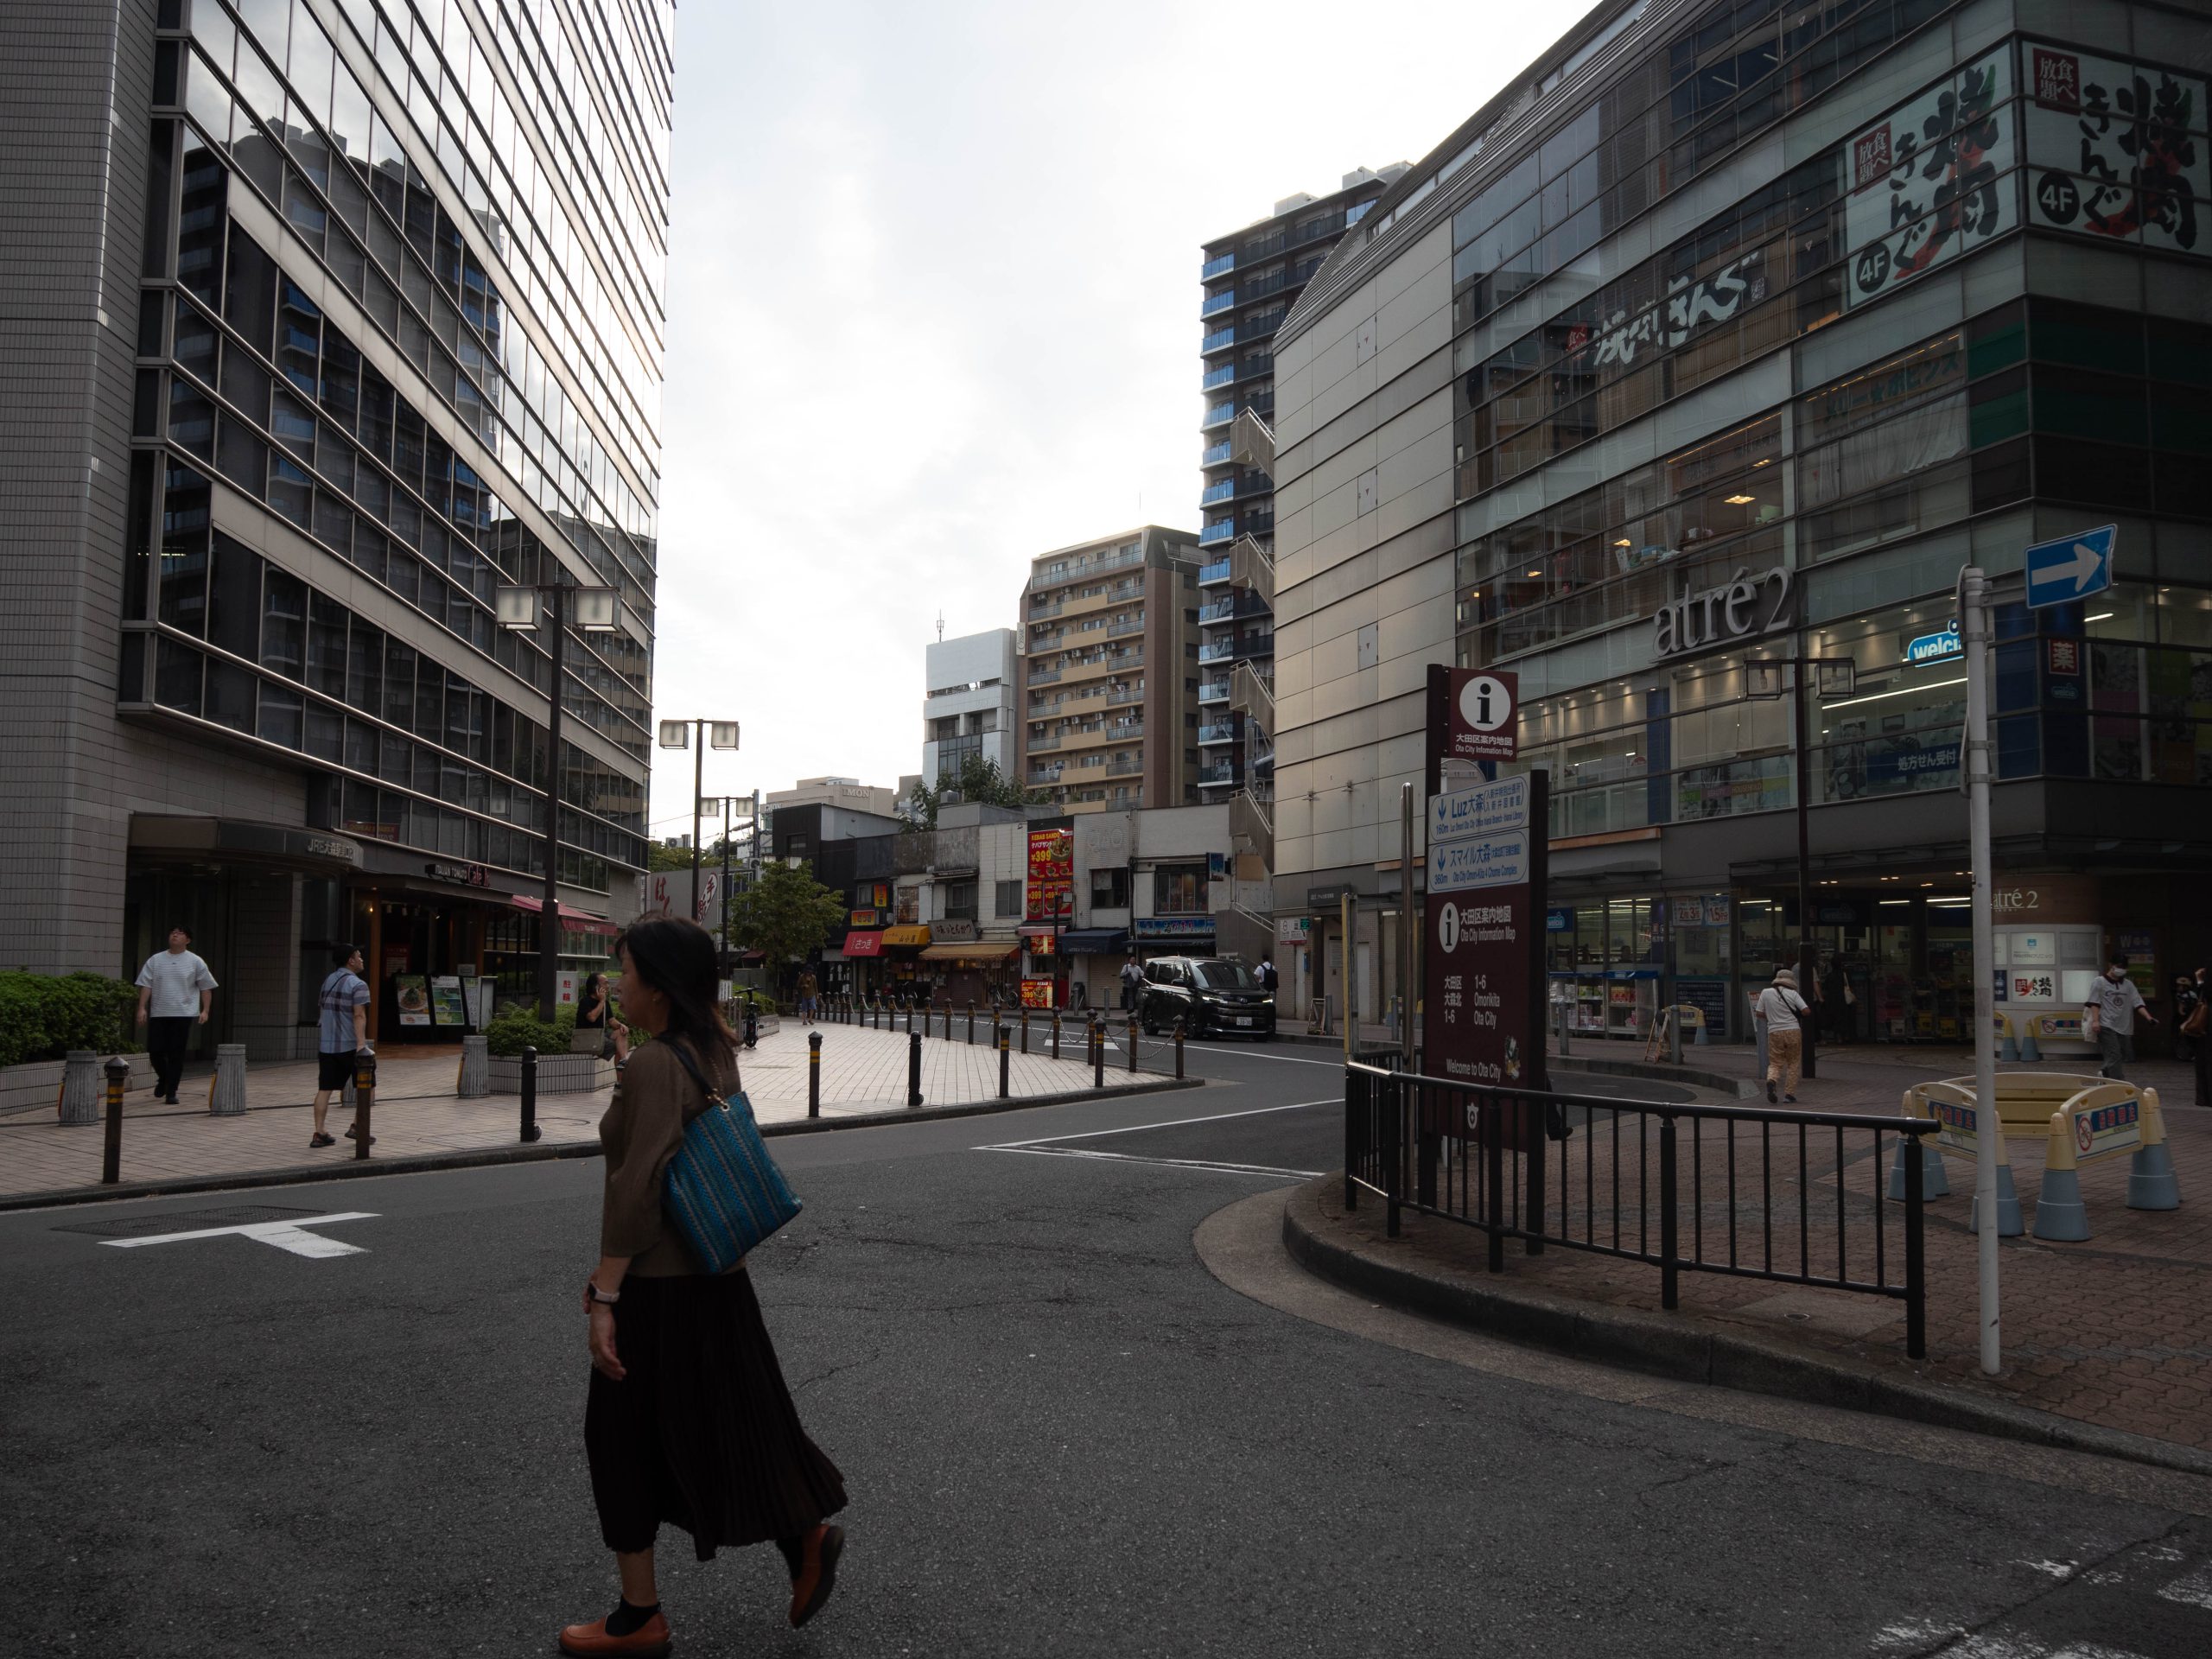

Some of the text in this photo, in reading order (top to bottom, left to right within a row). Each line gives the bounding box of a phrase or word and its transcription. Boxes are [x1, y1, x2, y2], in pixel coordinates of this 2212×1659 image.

[2078, 82, 2122, 232] きんぐ
[1890, 131, 1928, 270] きんぐ
[2042, 183, 2074, 212] 4F
[1859, 251, 1886, 284] 4F
[1653, 566, 1792, 657] atré 2
[2052, 642, 2075, 670] 薬
[1455, 733, 1514, 747] 大田区案内地図
[1455, 744, 1465, 753] Ota
[1465, 745, 1476, 755] City
[1503, 747, 1514, 757] Map
[1897, 748, 1957, 772] 処方せん受付
[842, 787, 871, 798] IMON
[1031, 849, 1052, 862] ¥399
[1450, 843, 1491, 868] スマイル大森
[1993, 888, 2039, 909] atré 2
[1460, 906, 1512, 925] 大田区案内地図
[855, 938, 873, 950] さつき
[1460, 925, 1516, 944] Ota City Information Map
[1444, 976, 1463, 990] 大田区
[1474, 975, 1487, 989] 1-6
[1445, 1008, 1456, 1023] 1-6
[1473, 1010, 1497, 1028] Ota City
[1446, 1057, 1502, 1083] Welcome to Ota City
